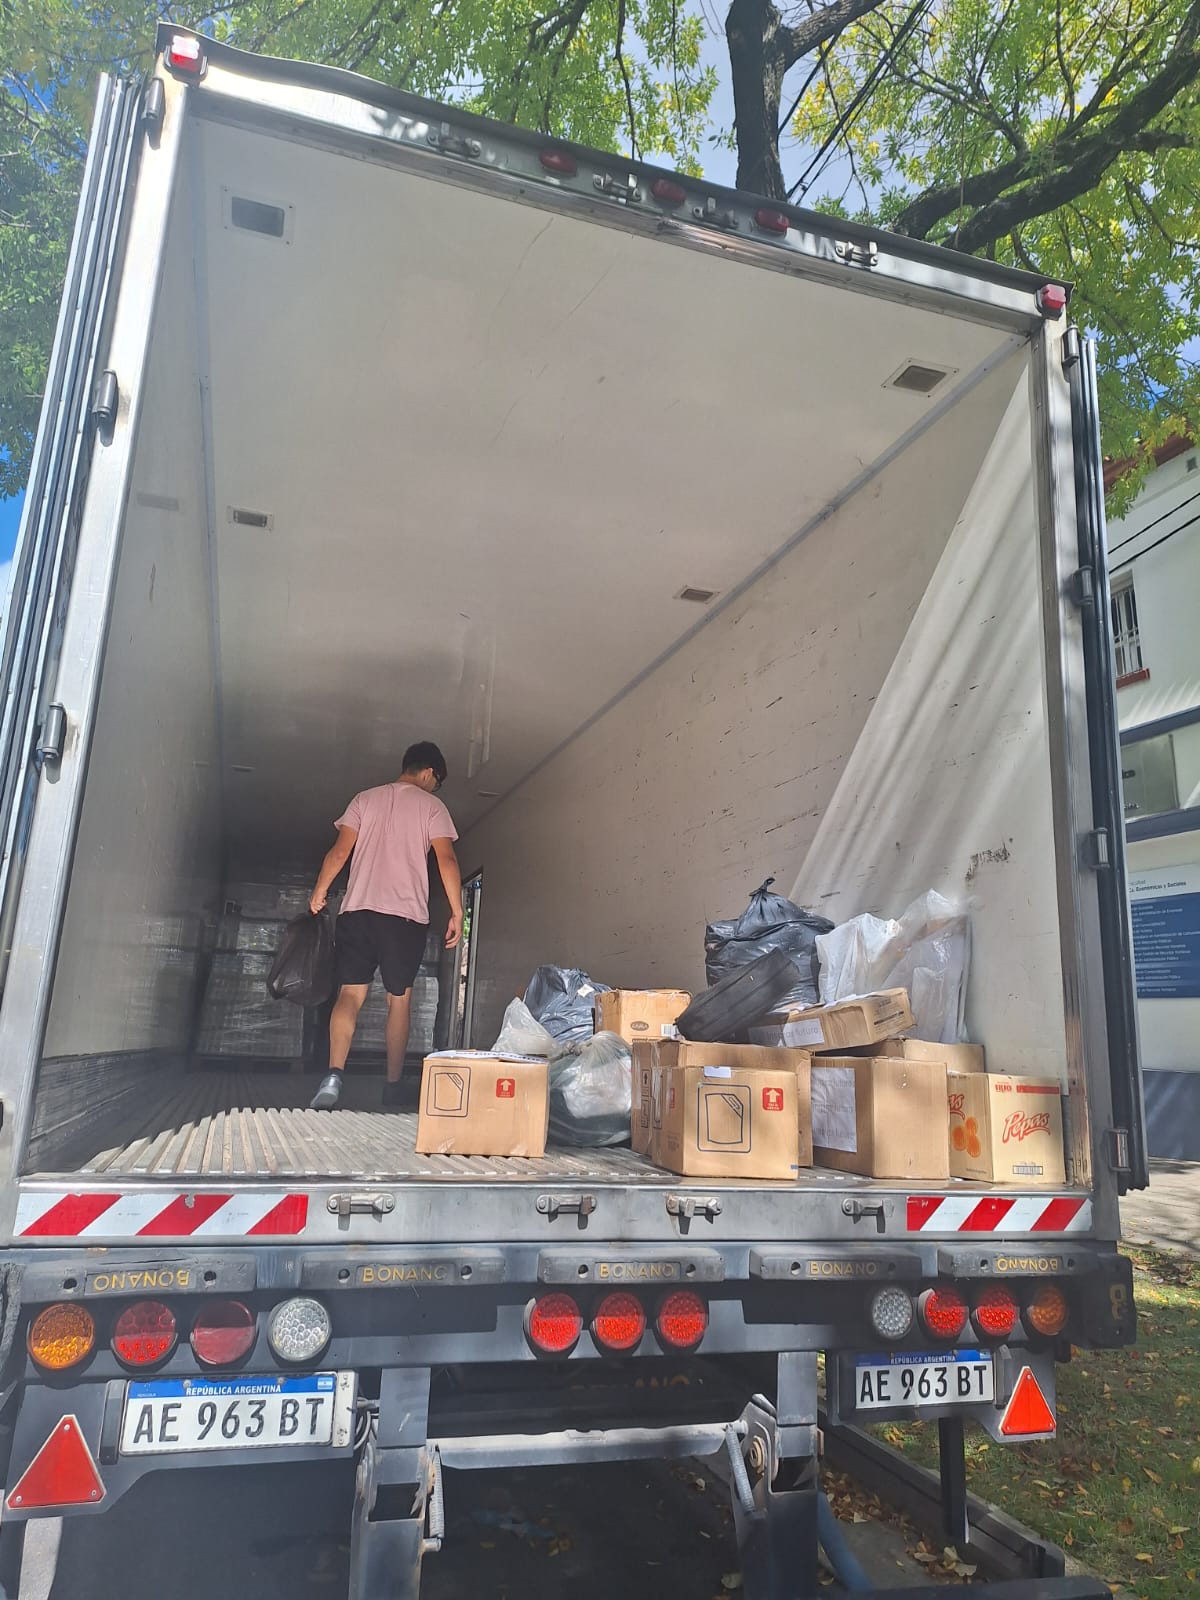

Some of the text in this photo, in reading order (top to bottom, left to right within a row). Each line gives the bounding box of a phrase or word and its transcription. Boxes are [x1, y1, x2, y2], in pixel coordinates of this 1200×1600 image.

[600, 1262, 674, 1279] BONANO
[809, 1261, 877, 1276] BONANO
[998, 1258, 1058, 1271] BONANO
[93, 1269, 190, 1292] BONANO
[924, 1354, 956, 1363] ARGENTINA
[186, 1384, 282, 1396] REPÚBLICA ARGENTINA
[860, 1365, 987, 1402] AE 963 BT
[133, 1397, 325, 1444] AE 963 BT
